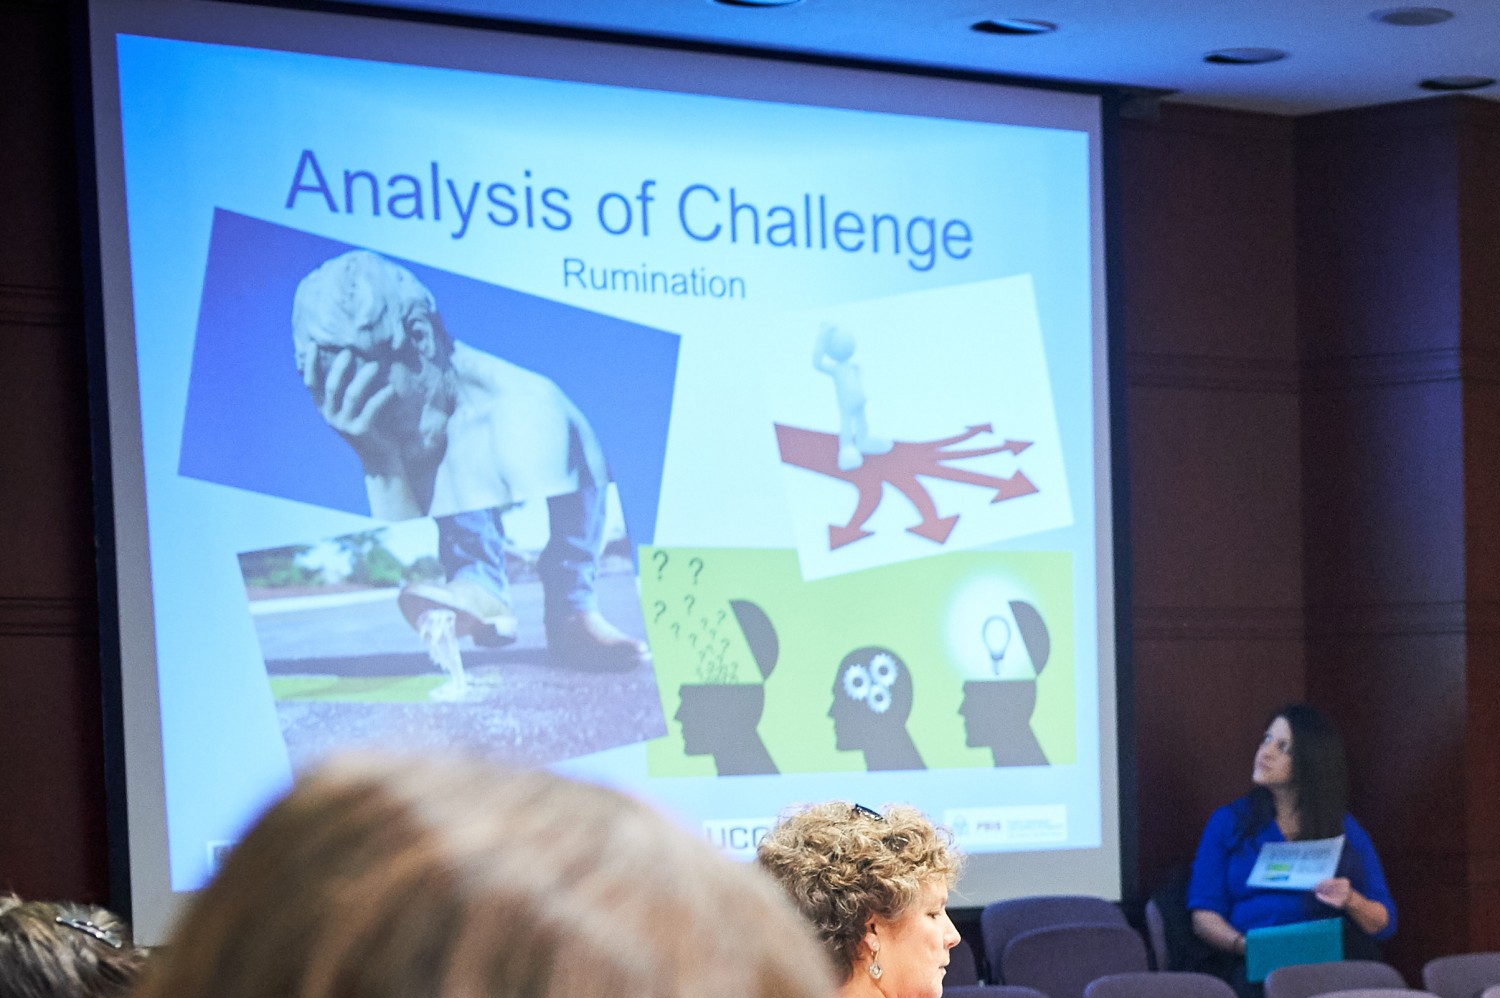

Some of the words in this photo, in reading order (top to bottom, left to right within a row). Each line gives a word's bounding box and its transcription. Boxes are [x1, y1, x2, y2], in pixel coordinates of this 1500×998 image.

[284, 148, 573, 240] Analysis
[597, 180, 657, 237] of
[678, 183, 974, 272] Challenge
[562, 257, 747, 299] Rumination
